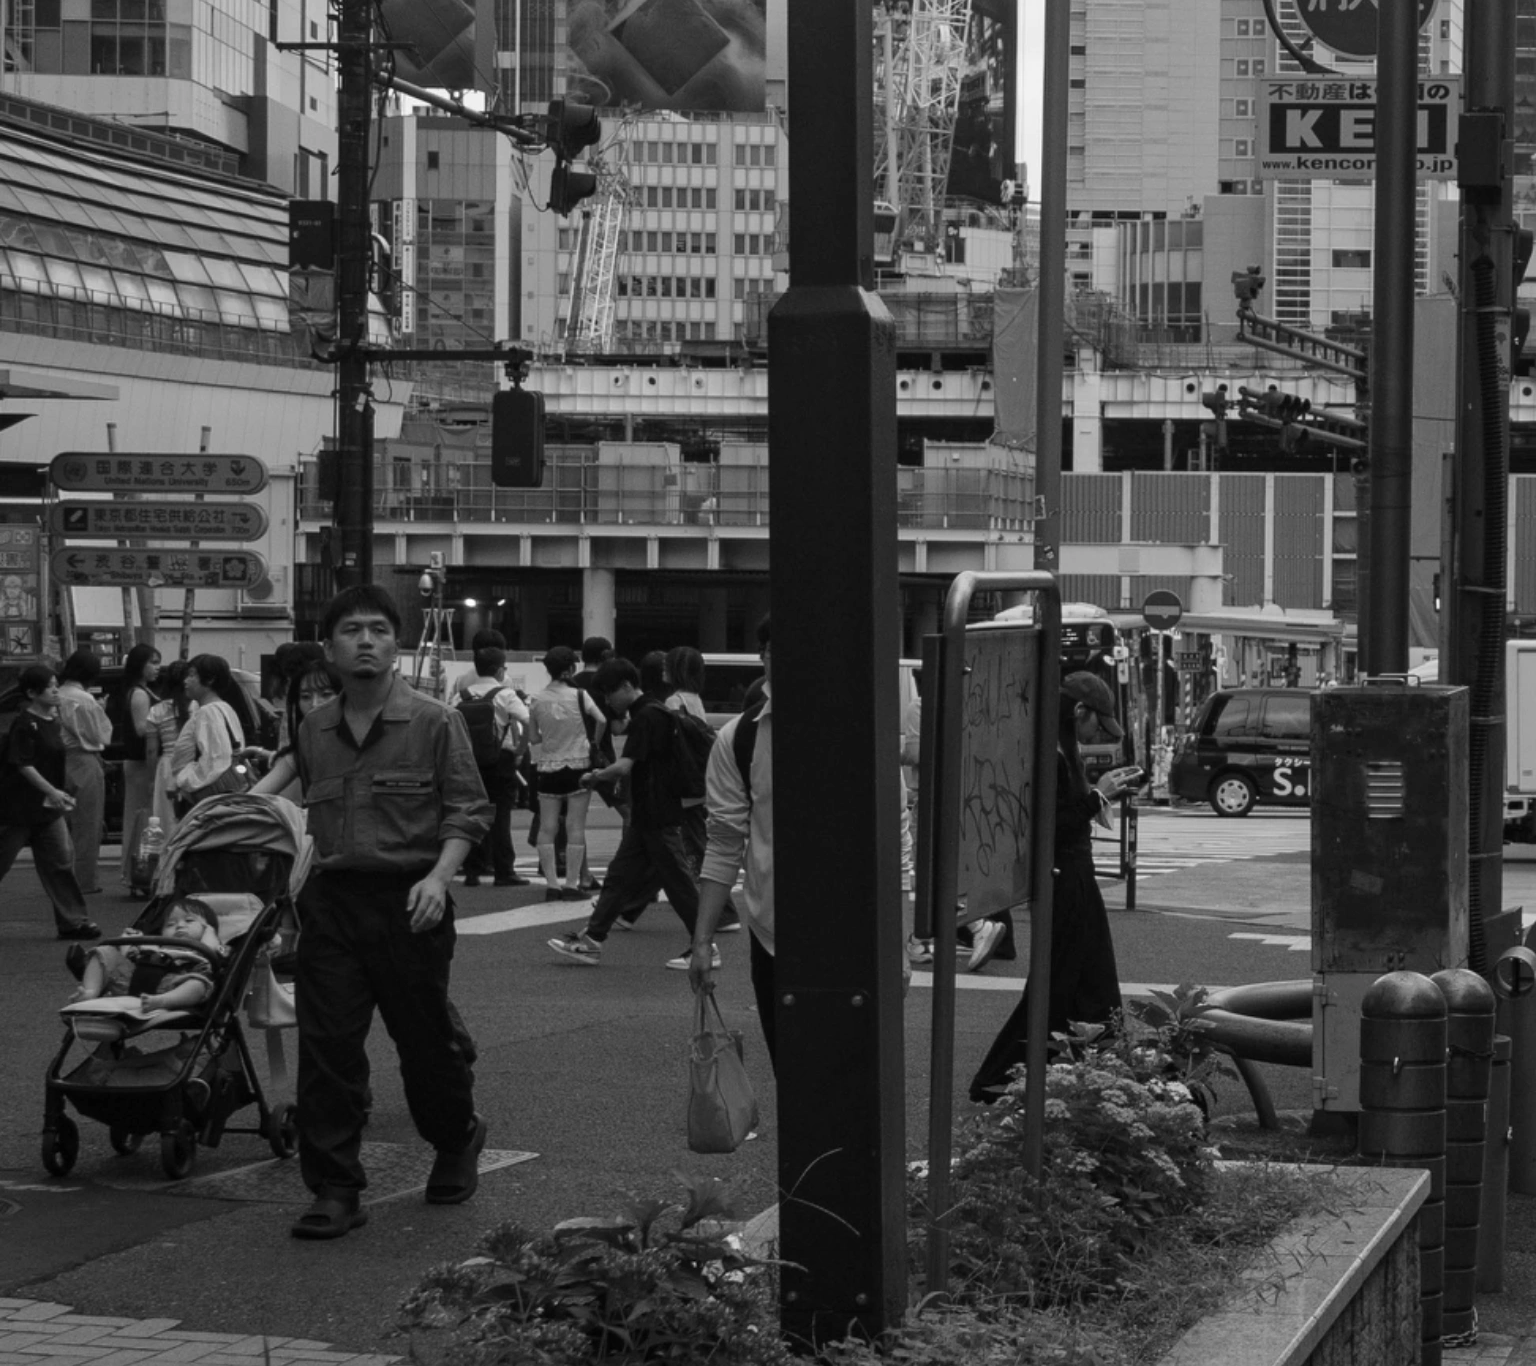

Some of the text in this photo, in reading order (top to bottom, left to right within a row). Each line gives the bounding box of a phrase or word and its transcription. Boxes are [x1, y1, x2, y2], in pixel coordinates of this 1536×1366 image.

[1268, 83, 1450, 101] 不動産はの
[1286, 109, 1430, 148] KE
[104, 477, 250, 487] United Nations University 650m
[1273, 767, 1311, 796] S.
